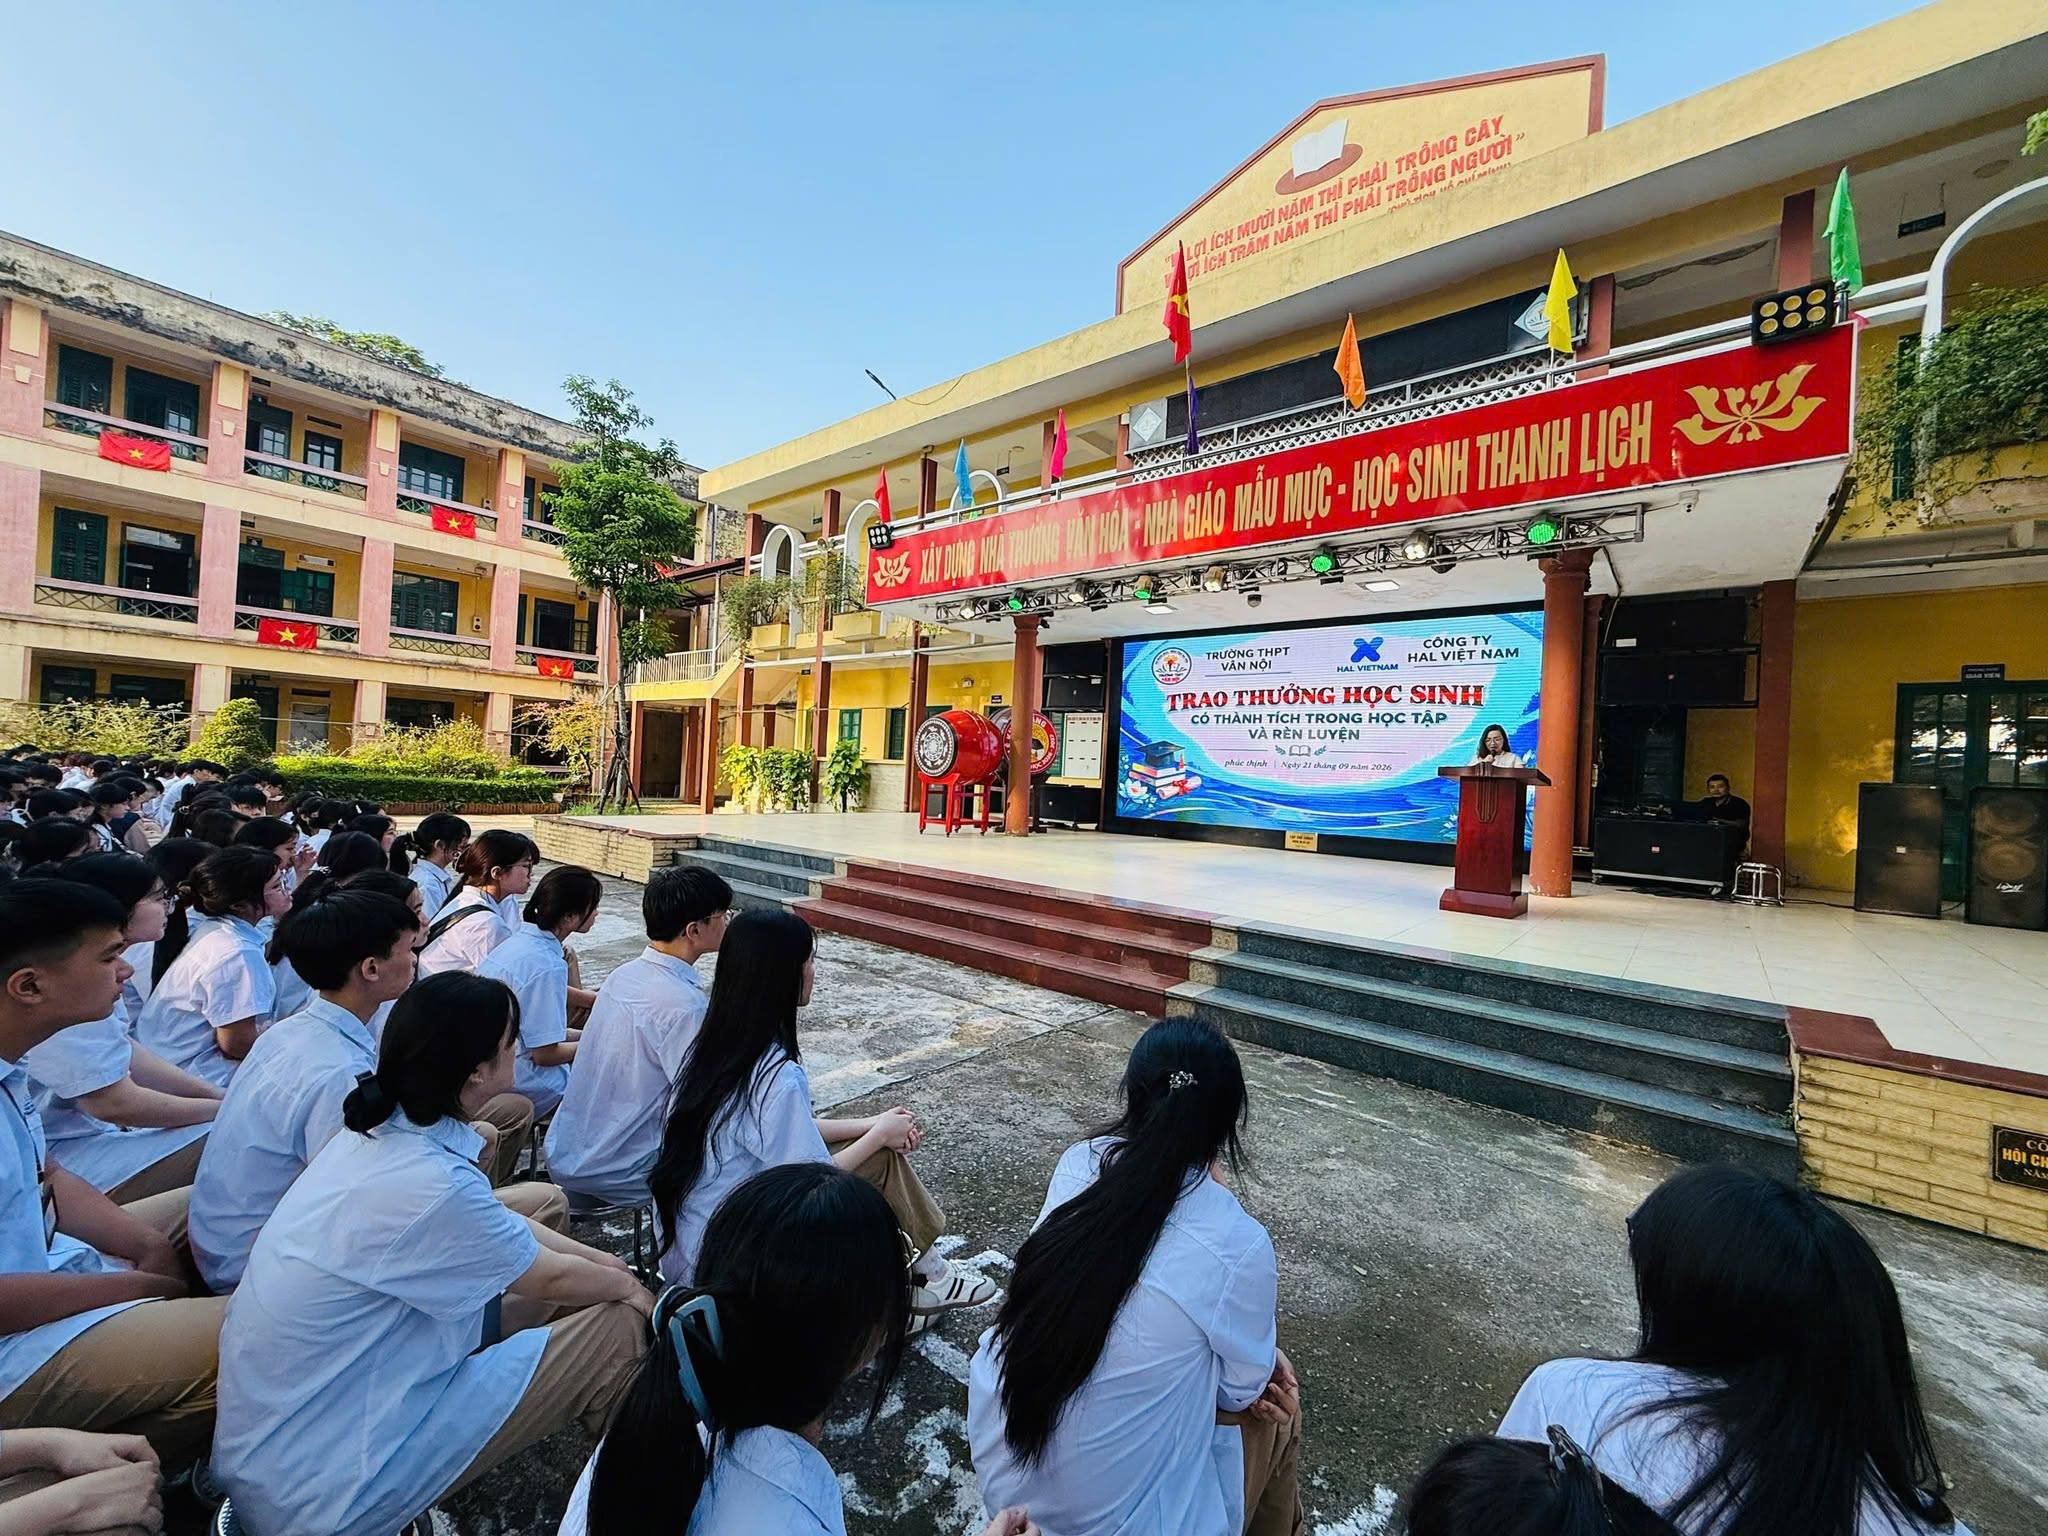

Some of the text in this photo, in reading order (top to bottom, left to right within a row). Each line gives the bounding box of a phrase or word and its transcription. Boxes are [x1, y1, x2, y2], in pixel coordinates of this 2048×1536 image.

[1210, 231, 1233, 251] ÍCH
[1237, 208, 1275, 240] MƯỜI
[1278, 196, 1314, 223] NĂM
[1319, 177, 1343, 207] THÌ
[1347, 159, 1388, 194] PHẢI
[1395, 134, 1458, 174] TRỒNG
[1464, 114, 1504, 147] CÂY
[1203, 251, 1227, 274] ÍCH
[1229, 234, 1270, 264] TRĂM
[1273, 218, 1310, 246] NĂM
[1314, 201, 1338, 229] THÌ
[1342, 185, 1382, 219] PHẢI
[1386, 163, 1446, 201] TRỒNG
[919, 541, 943, 585] XÂY
[943, 538, 976, 586] DỰNG
[979, 526, 1005, 575] NHÀ
[1008, 515, 1060, 569] TRƯỜNG
[1066, 511, 1096, 560] VĂN
[1099, 500, 1129, 555] HÓA
[1143, 489, 1178, 547] NHÀ
[1183, 481, 1226, 541] GIÁO
[1233, 464, 1279, 532] MẪU
[1283, 463, 1333, 530] MỰC
[1351, 453, 1400, 519] HỌC
[1406, 438, 1469, 503] SINH
[1476, 413, 1571, 491] THANH
[1579, 400, 1653, 482] LỊCH
[1423, 635, 1492, 649] CÔNG TY
[1206, 647, 1290, 661] TRƯỜNG THPT
[1408, 647, 1519, 663] HAL VIỆT NAM
[1249, 659, 1272, 673] NỘI
[1336, 664, 1399, 673] HAL VIETNAM
[1166, 683, 1485, 713] TRAO THƯỞNG HỌC SINH
[1191, 710, 1448, 728] CÓ THÀNH TÍCH TRONG HỌC TẬP
[1248, 727, 1360, 743] VÀ RÈN LUYỆN
[1280, 760, 1301, 770] Ngày
[1302, 761, 1312, 769] 21
[1313, 761, 1337, 771] tháng
[1338, 762, 1350, 770] 09
[1371, 763, 1393, 771] 2026
[2002, 1147, 2027, 1165] HỘI
